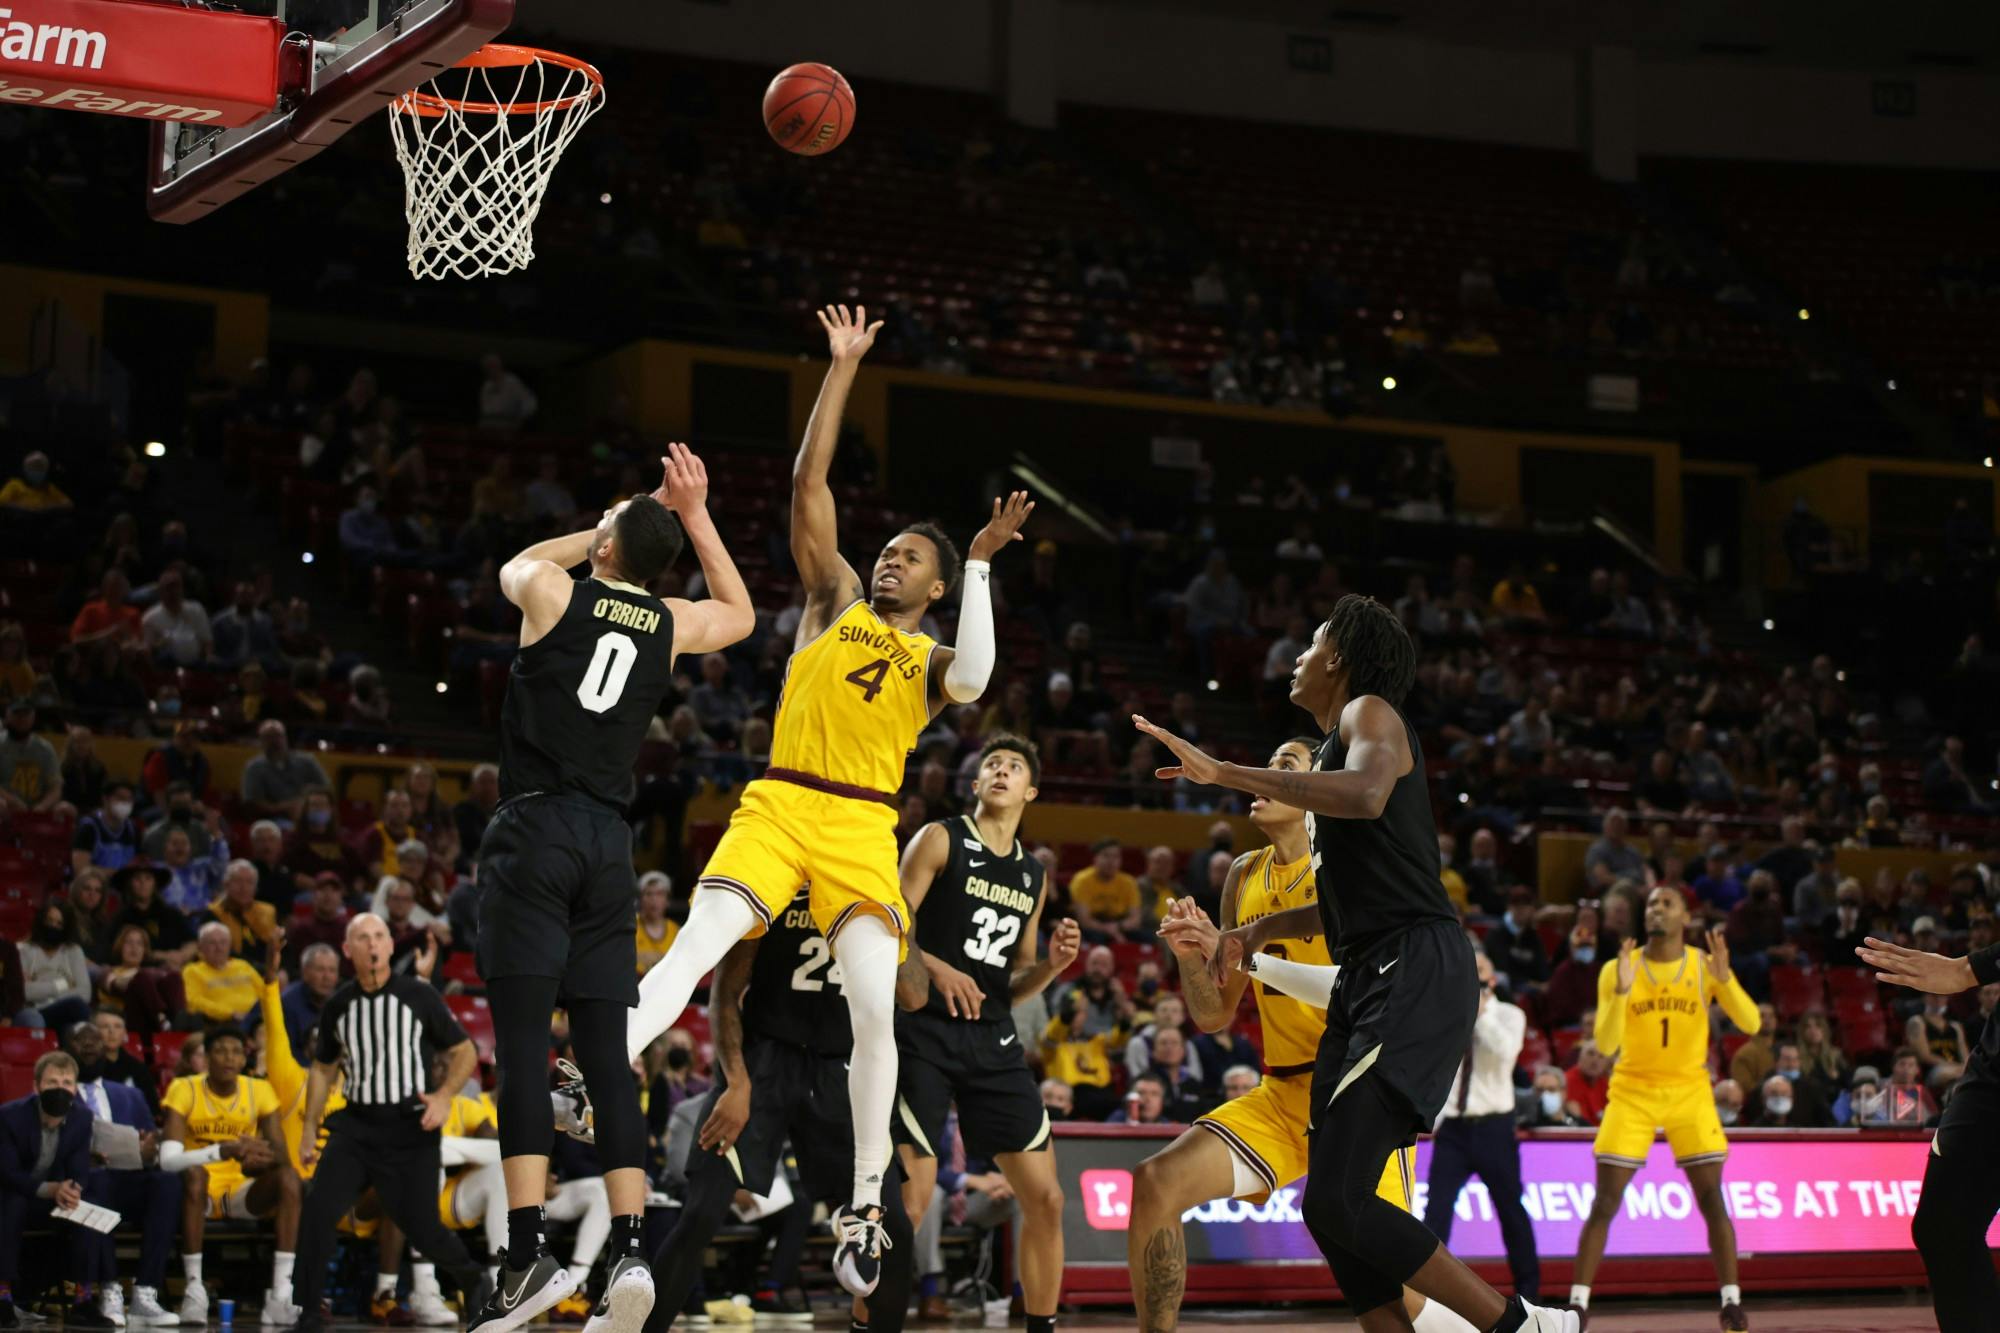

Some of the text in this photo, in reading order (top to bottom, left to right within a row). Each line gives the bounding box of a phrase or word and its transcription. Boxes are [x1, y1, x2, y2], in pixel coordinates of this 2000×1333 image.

[40, 88, 223, 121] Farm
[593, 598, 660, 634] O'BRIEN
[839, 626, 874, 647] SUN
[577, 631, 639, 713] 0
[845, 659, 891, 703] 4
[965, 875, 1035, 916] COLORADO
[963, 907, 1021, 969] 32
[1632, 997, 1698, 1017] SUN DEVILS
[1660, 1017, 1669, 1048] 1
[1793, 1181, 1840, 1218] AT
[1848, 1180, 1922, 1217] THE
